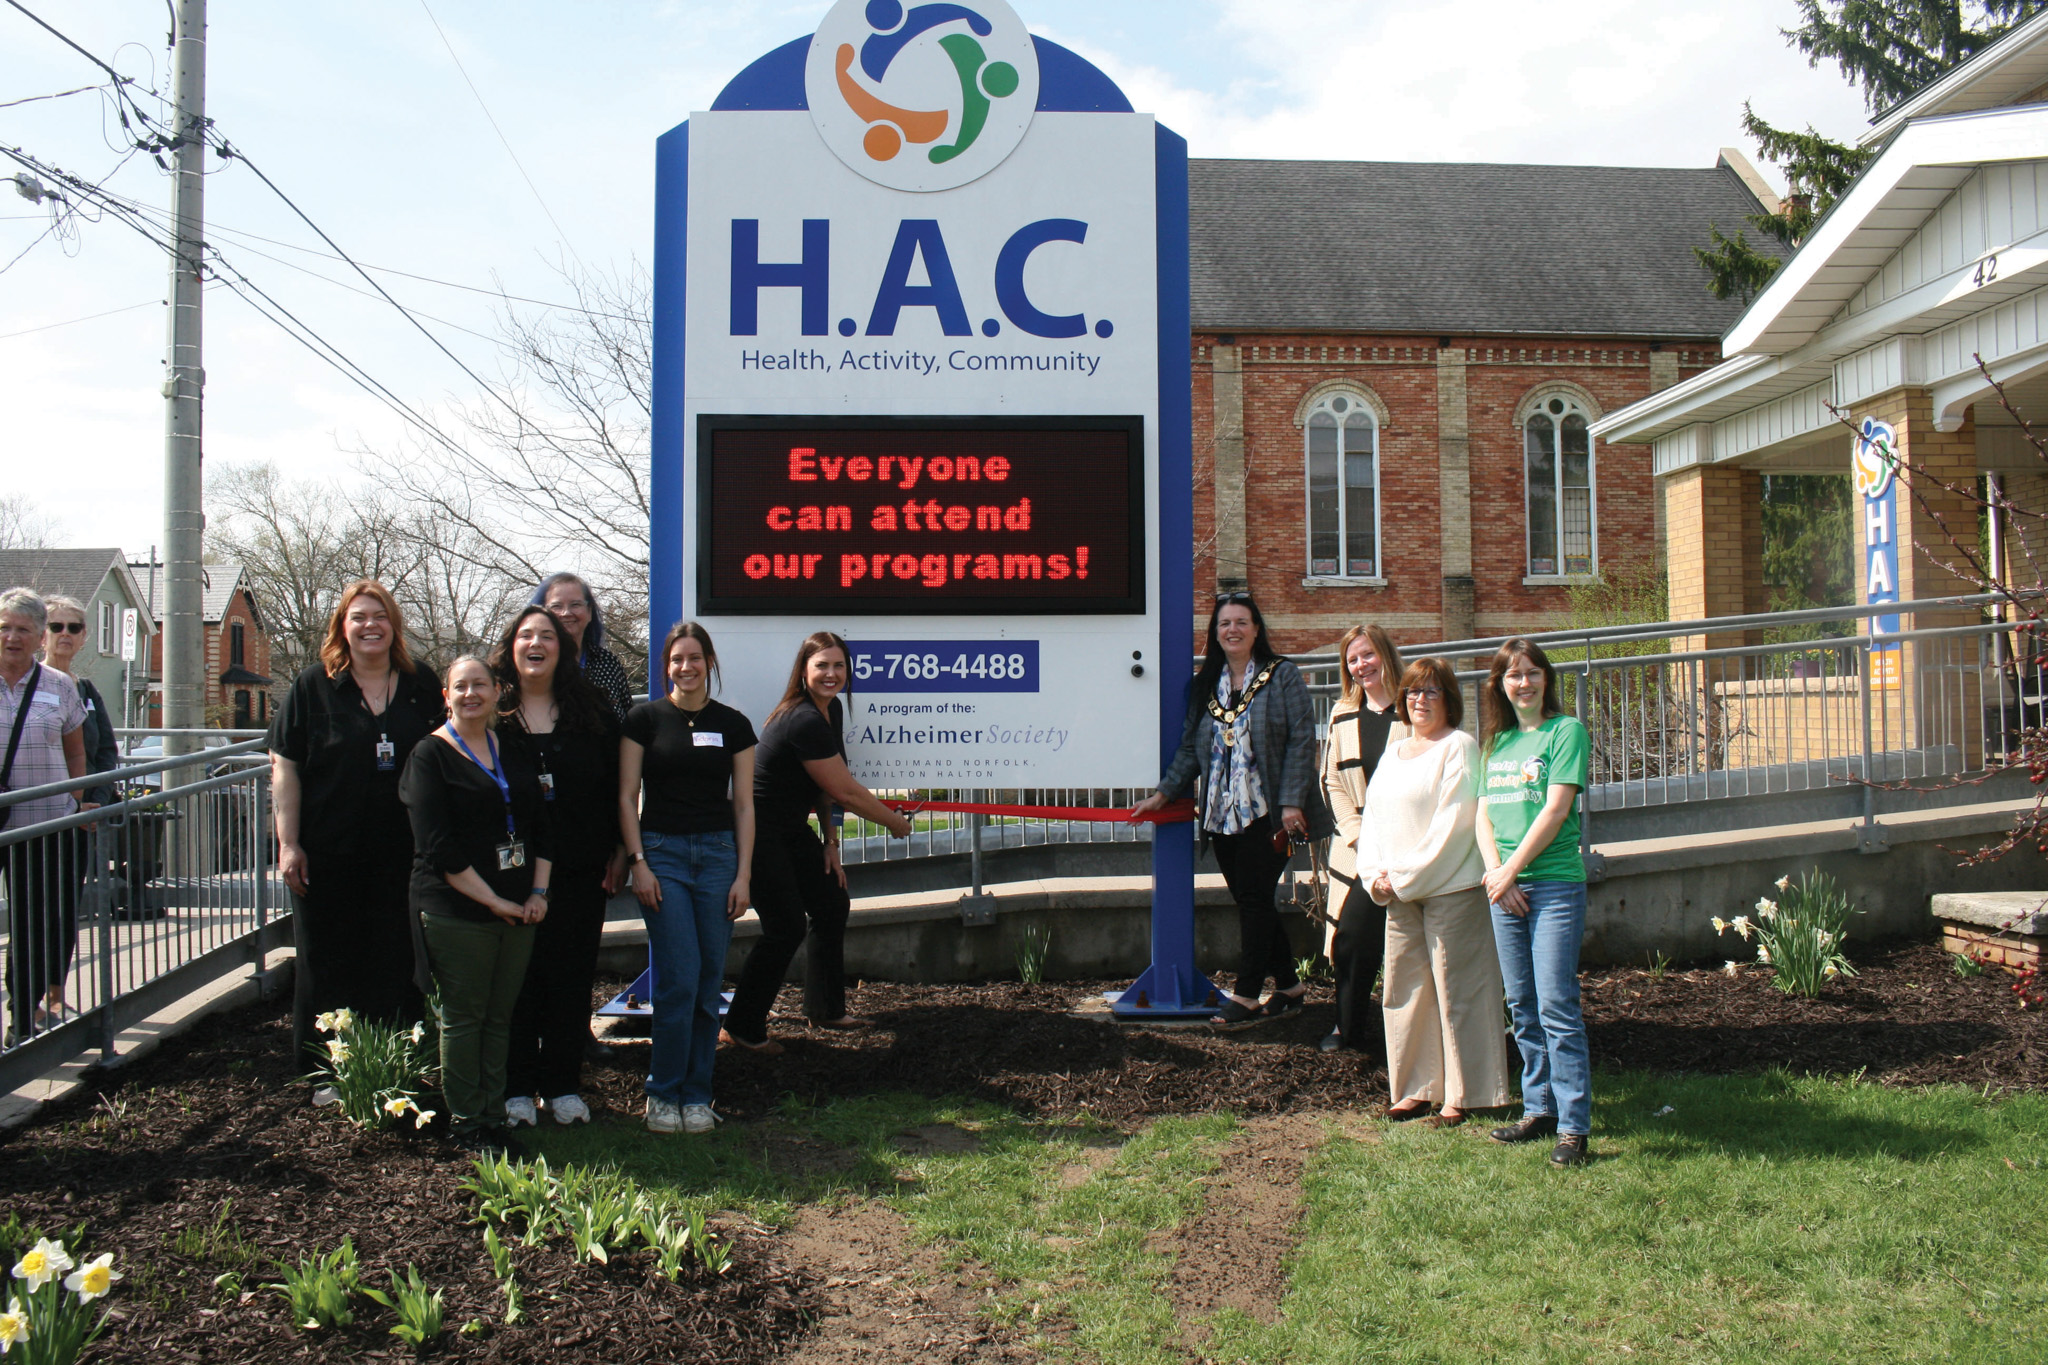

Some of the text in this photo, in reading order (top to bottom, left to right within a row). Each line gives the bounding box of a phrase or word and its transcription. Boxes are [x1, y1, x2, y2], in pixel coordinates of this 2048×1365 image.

[730, 218, 1114, 339] H.A.C.
[1973, 255, 1997, 288] 42
[742, 348, 1101, 377] Health, Activity, Community
[788, 447, 1012, 489] Everyone
[766, 497, 1031, 532] can attend
[743, 545, 1090, 588] our programs!
[850, 653, 1025, 680] 5-768-4488
[867, 703, 976, 716] A program of the:
[859, 724, 984, 744] Alzheimer
[986, 723, 1069, 752] Society
[850, 770, 994, 779] HAMILTON HALTON
[865, 759, 953, 768] HALDIMAND
